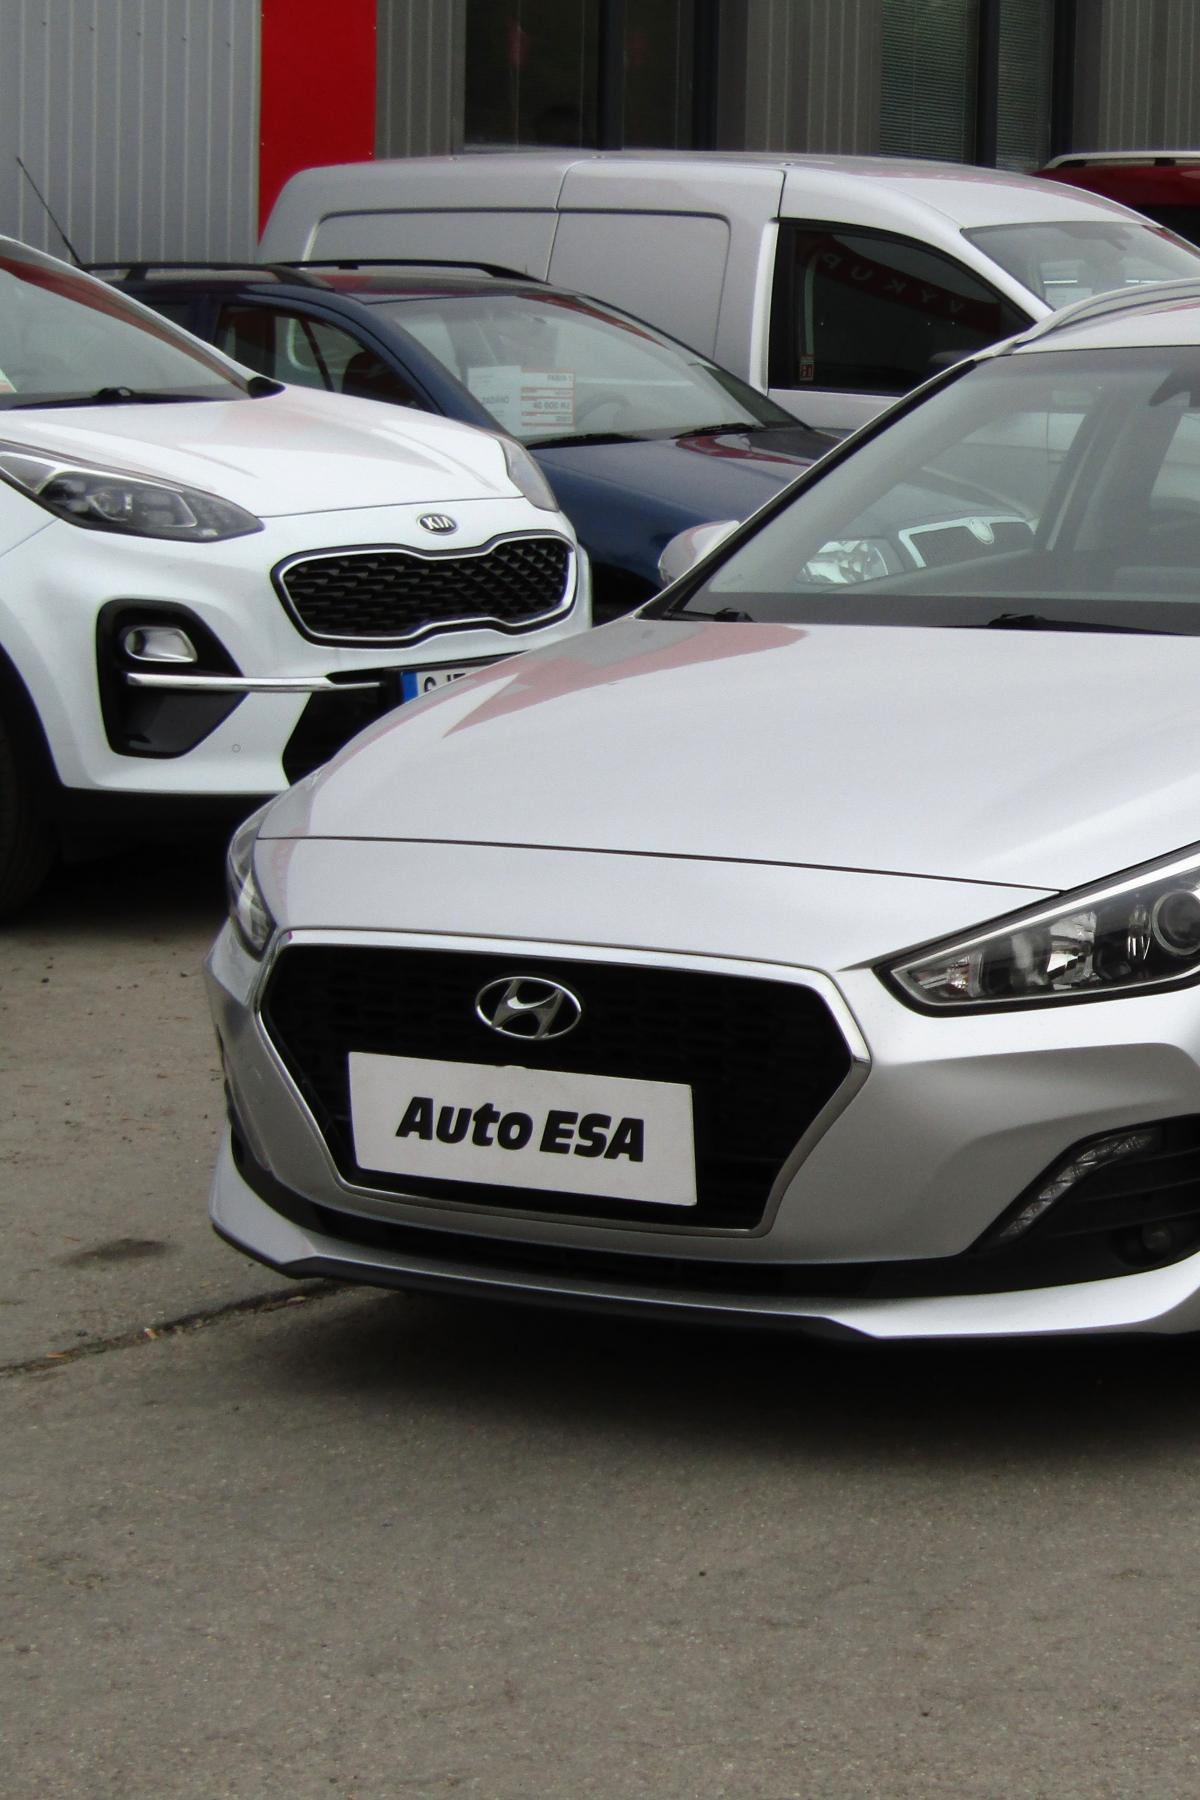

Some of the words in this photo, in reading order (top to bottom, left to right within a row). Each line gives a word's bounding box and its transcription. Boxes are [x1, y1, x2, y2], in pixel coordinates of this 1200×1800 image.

[422, 516, 455, 530] KIA
[396, 1097, 533, 1151] Auto
[540, 1110, 645, 1162] ESA
